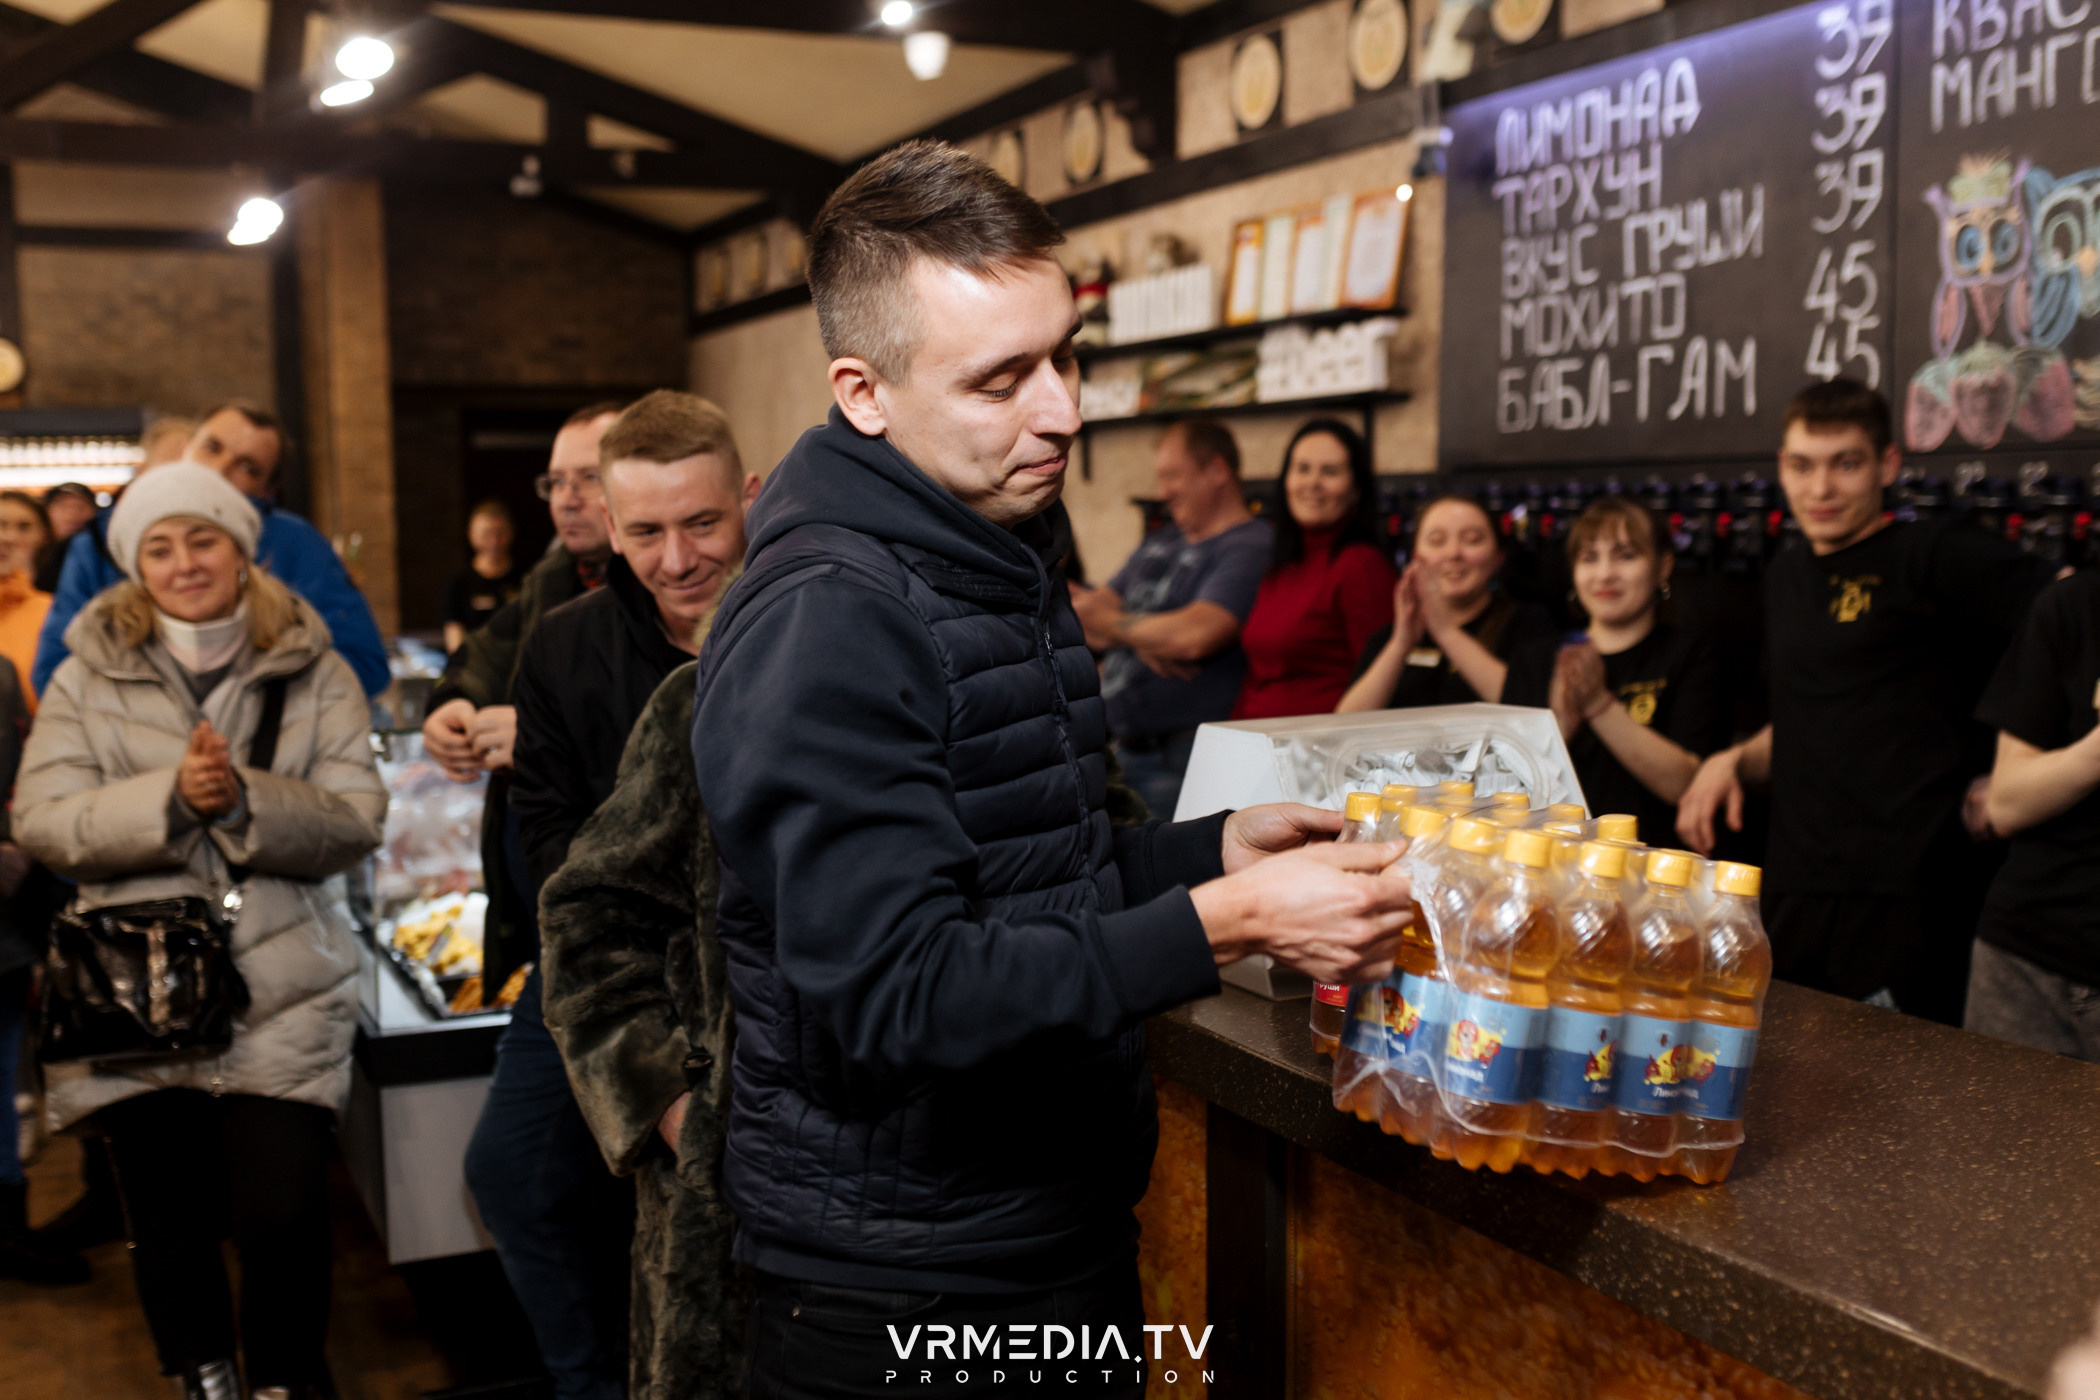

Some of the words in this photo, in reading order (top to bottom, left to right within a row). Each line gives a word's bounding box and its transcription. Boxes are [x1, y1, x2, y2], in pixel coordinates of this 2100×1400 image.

[1491, 140, 1663, 235] ТАРХУН
[1812, 72, 1886, 153] 39
[1496, 57, 1701, 176] ЛИМОНАД
[1815, 0, 1893, 79] 39
[1501, 222, 1598, 299] ВКУС
[1622, 185, 1764, 278] ГРУШИ
[1811, 148, 1884, 233] 39
[1497, 335, 1756, 433] БАБЛ-ГАМ
[1805, 316, 1880, 391] 45
[1501, 272, 1687, 360] МОХИТО
[1804, 240, 1878, 323] 45
